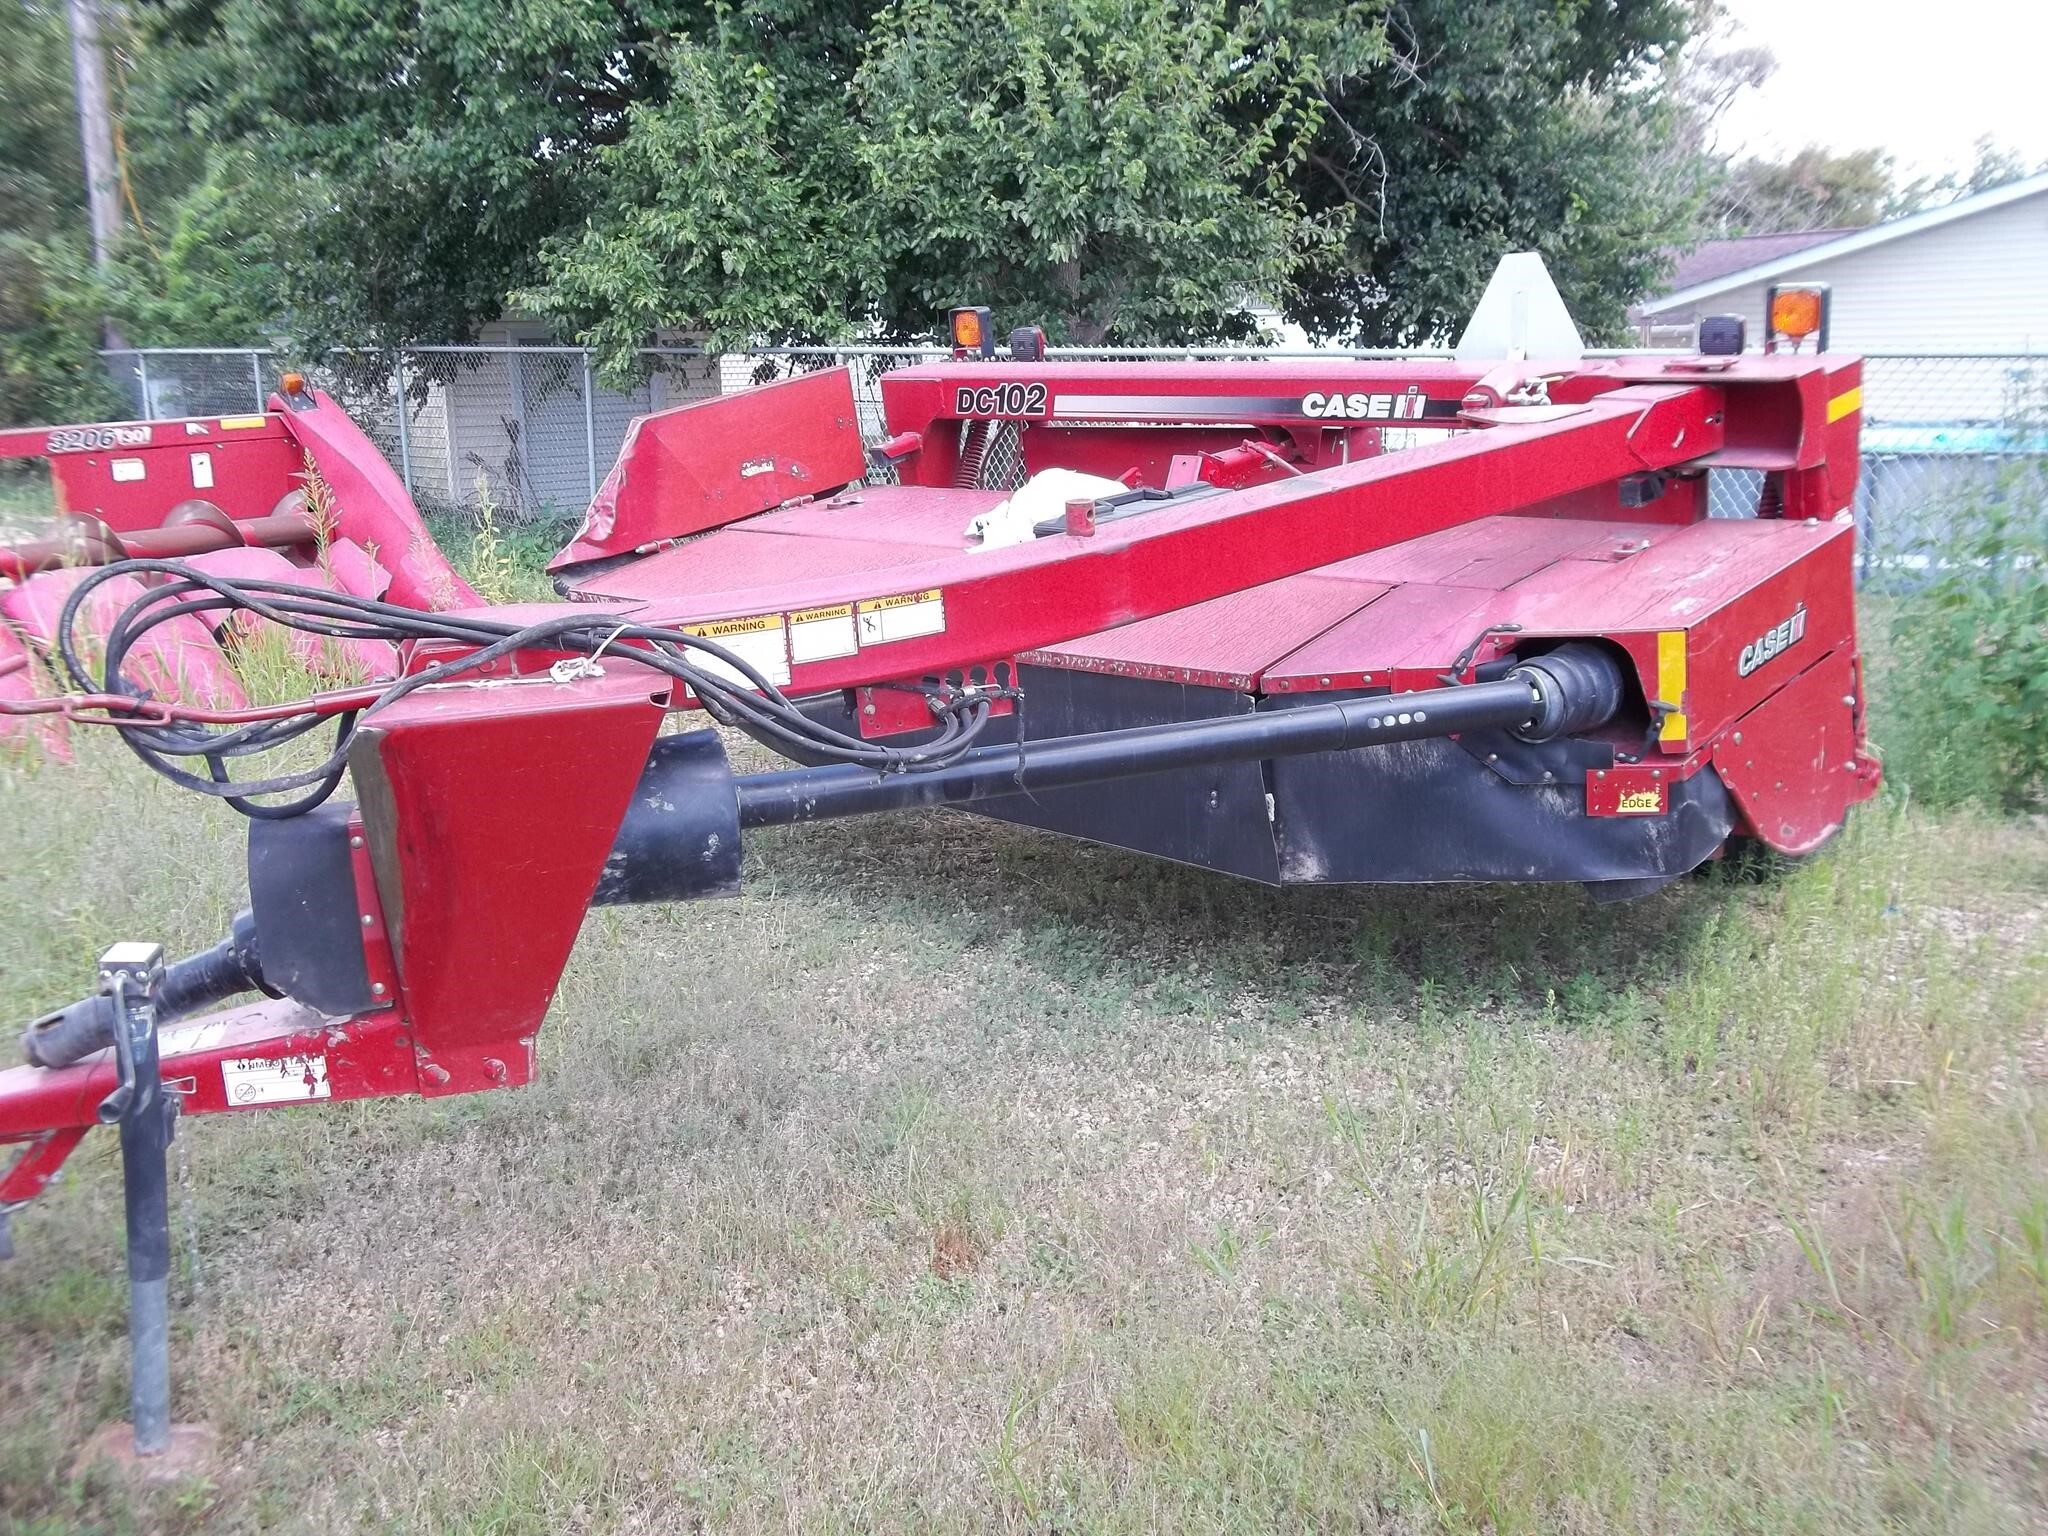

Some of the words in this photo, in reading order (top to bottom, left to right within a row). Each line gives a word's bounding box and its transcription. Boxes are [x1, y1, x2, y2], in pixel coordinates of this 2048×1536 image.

[956, 382, 1048, 416] DC102
[885, 592, 930, 608] WARNING
[806, 607, 847, 622] WARNING
[711, 620, 766, 637] WARNING
[1621, 798, 1653, 810] EDGE
